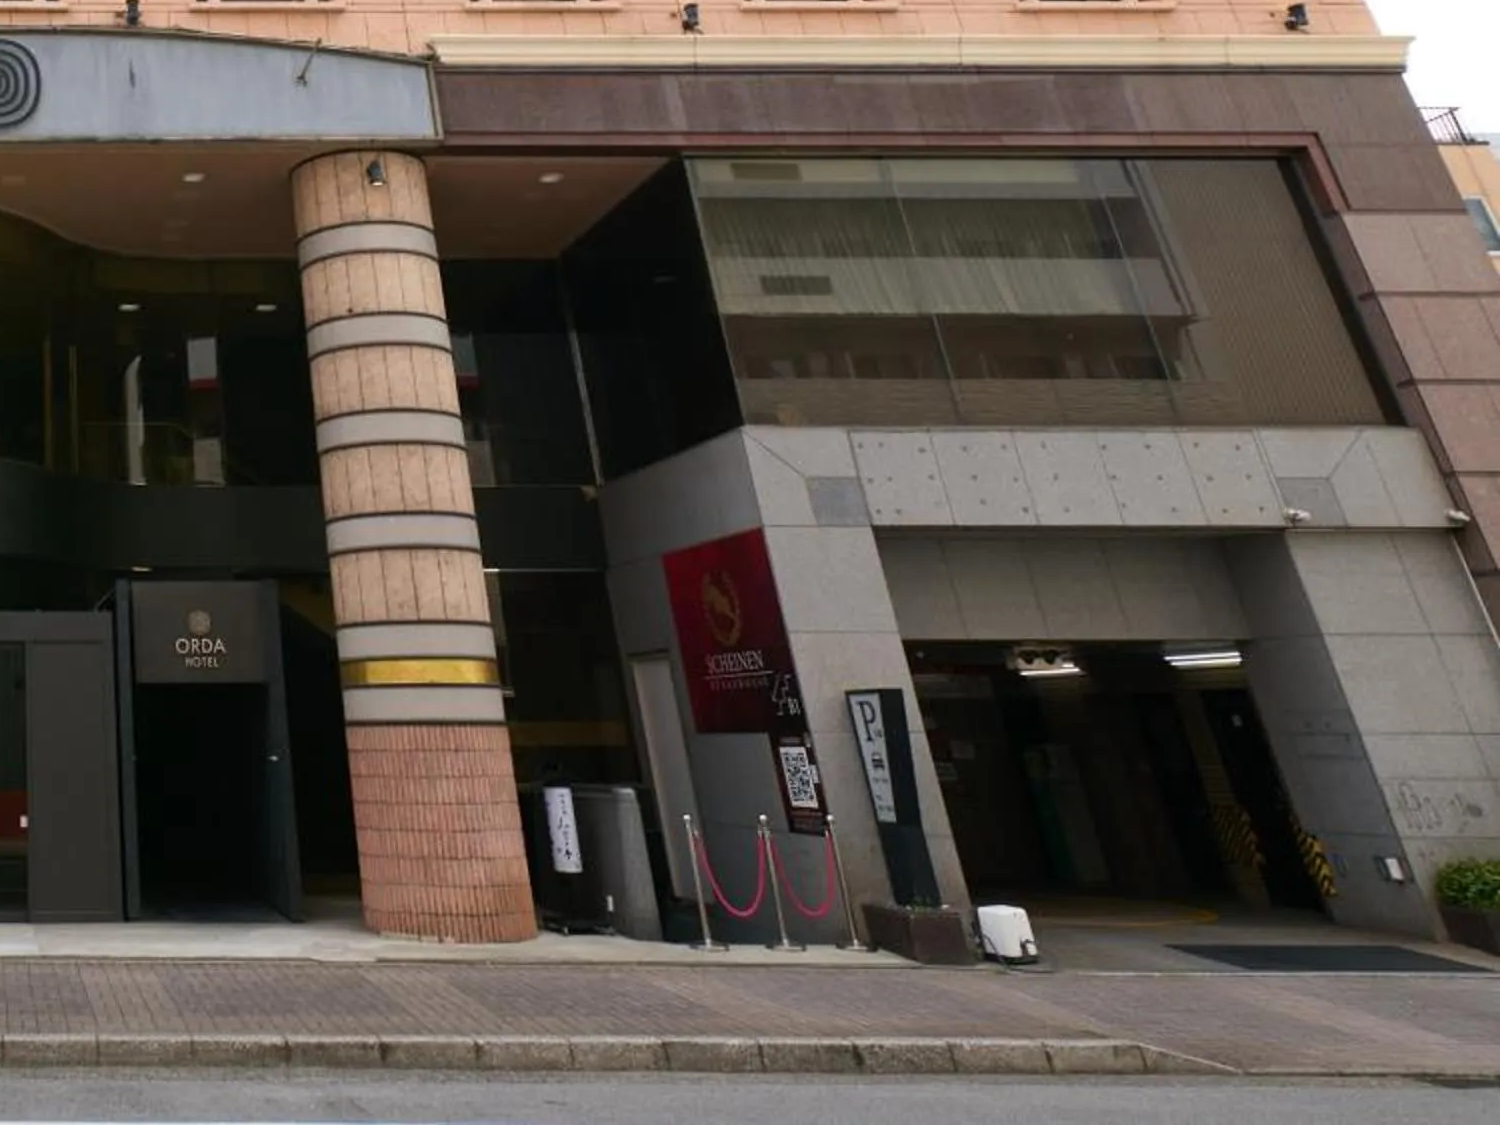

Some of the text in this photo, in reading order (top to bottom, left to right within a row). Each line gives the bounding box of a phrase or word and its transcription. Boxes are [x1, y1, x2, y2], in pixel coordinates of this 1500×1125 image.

[175, 638, 227, 654] ORDA
[185, 656, 219, 668] HOTEL
[855, 700, 876, 742] P
